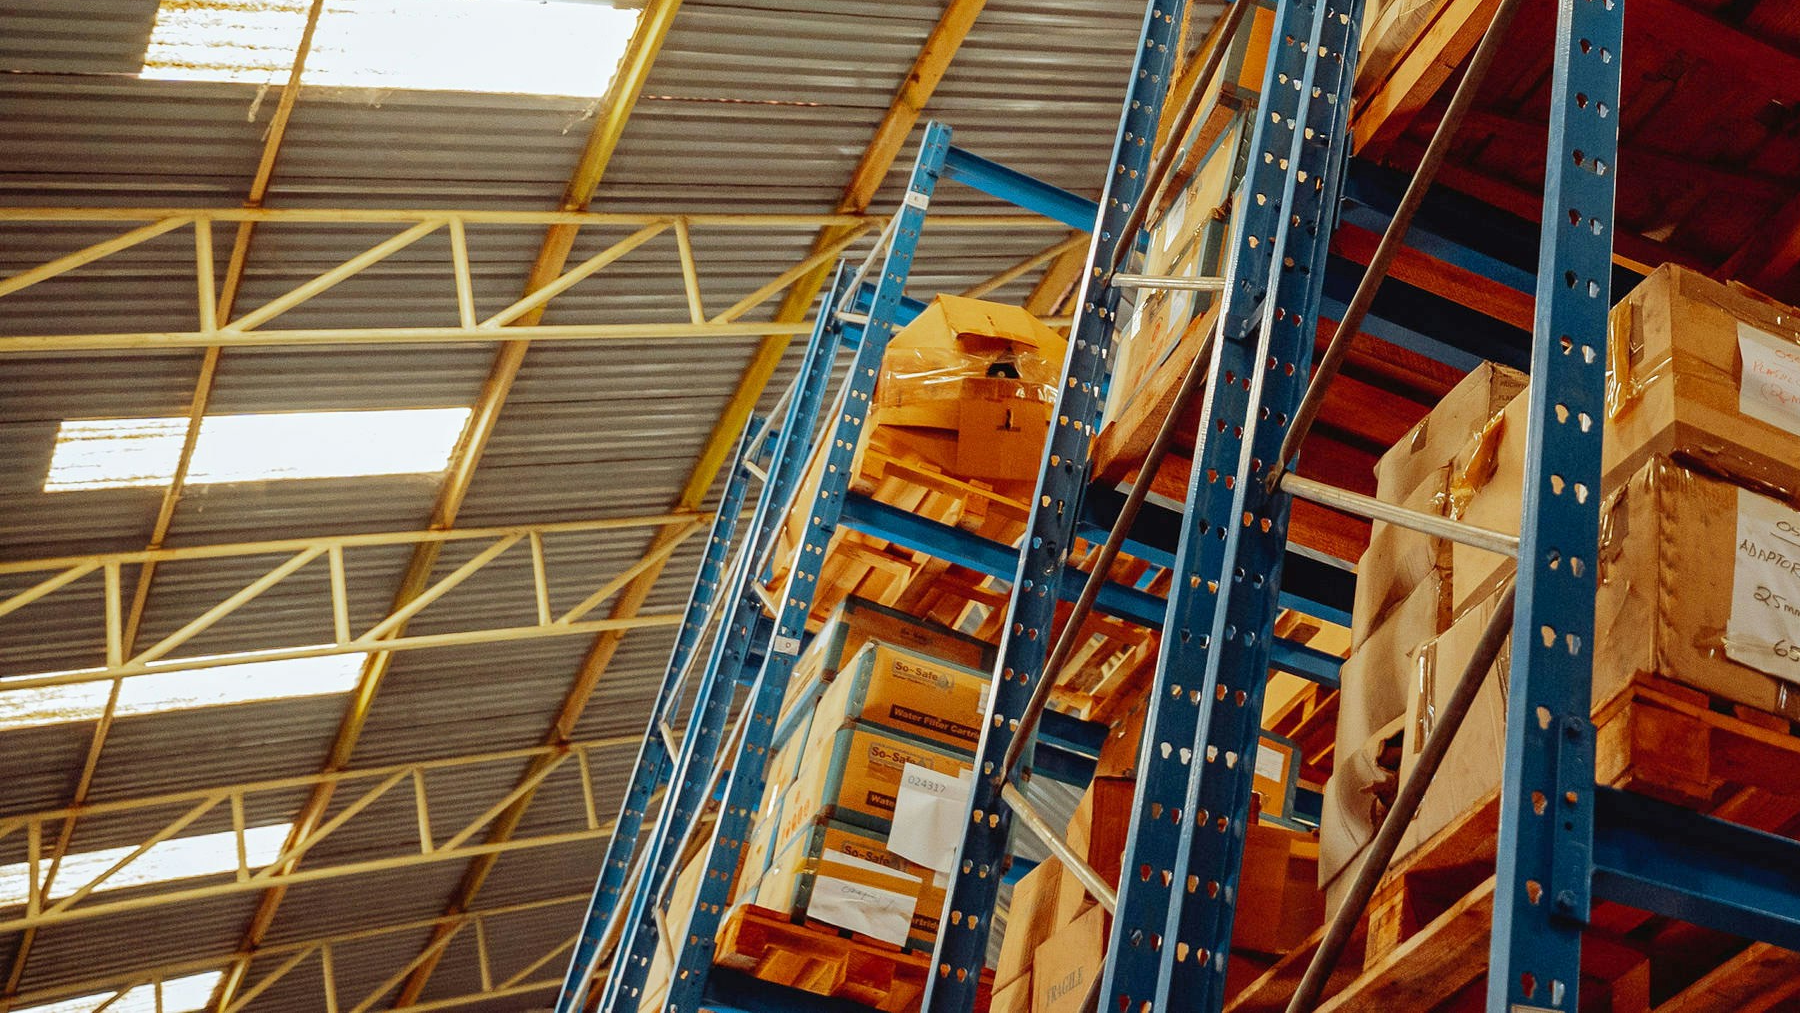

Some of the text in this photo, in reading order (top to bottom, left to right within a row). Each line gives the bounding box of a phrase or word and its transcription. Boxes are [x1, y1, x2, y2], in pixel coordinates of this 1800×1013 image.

[893, 707, 922, 724] Water
[924, 717, 949, 731] Filter
[908, 775, 946, 793] 024317
